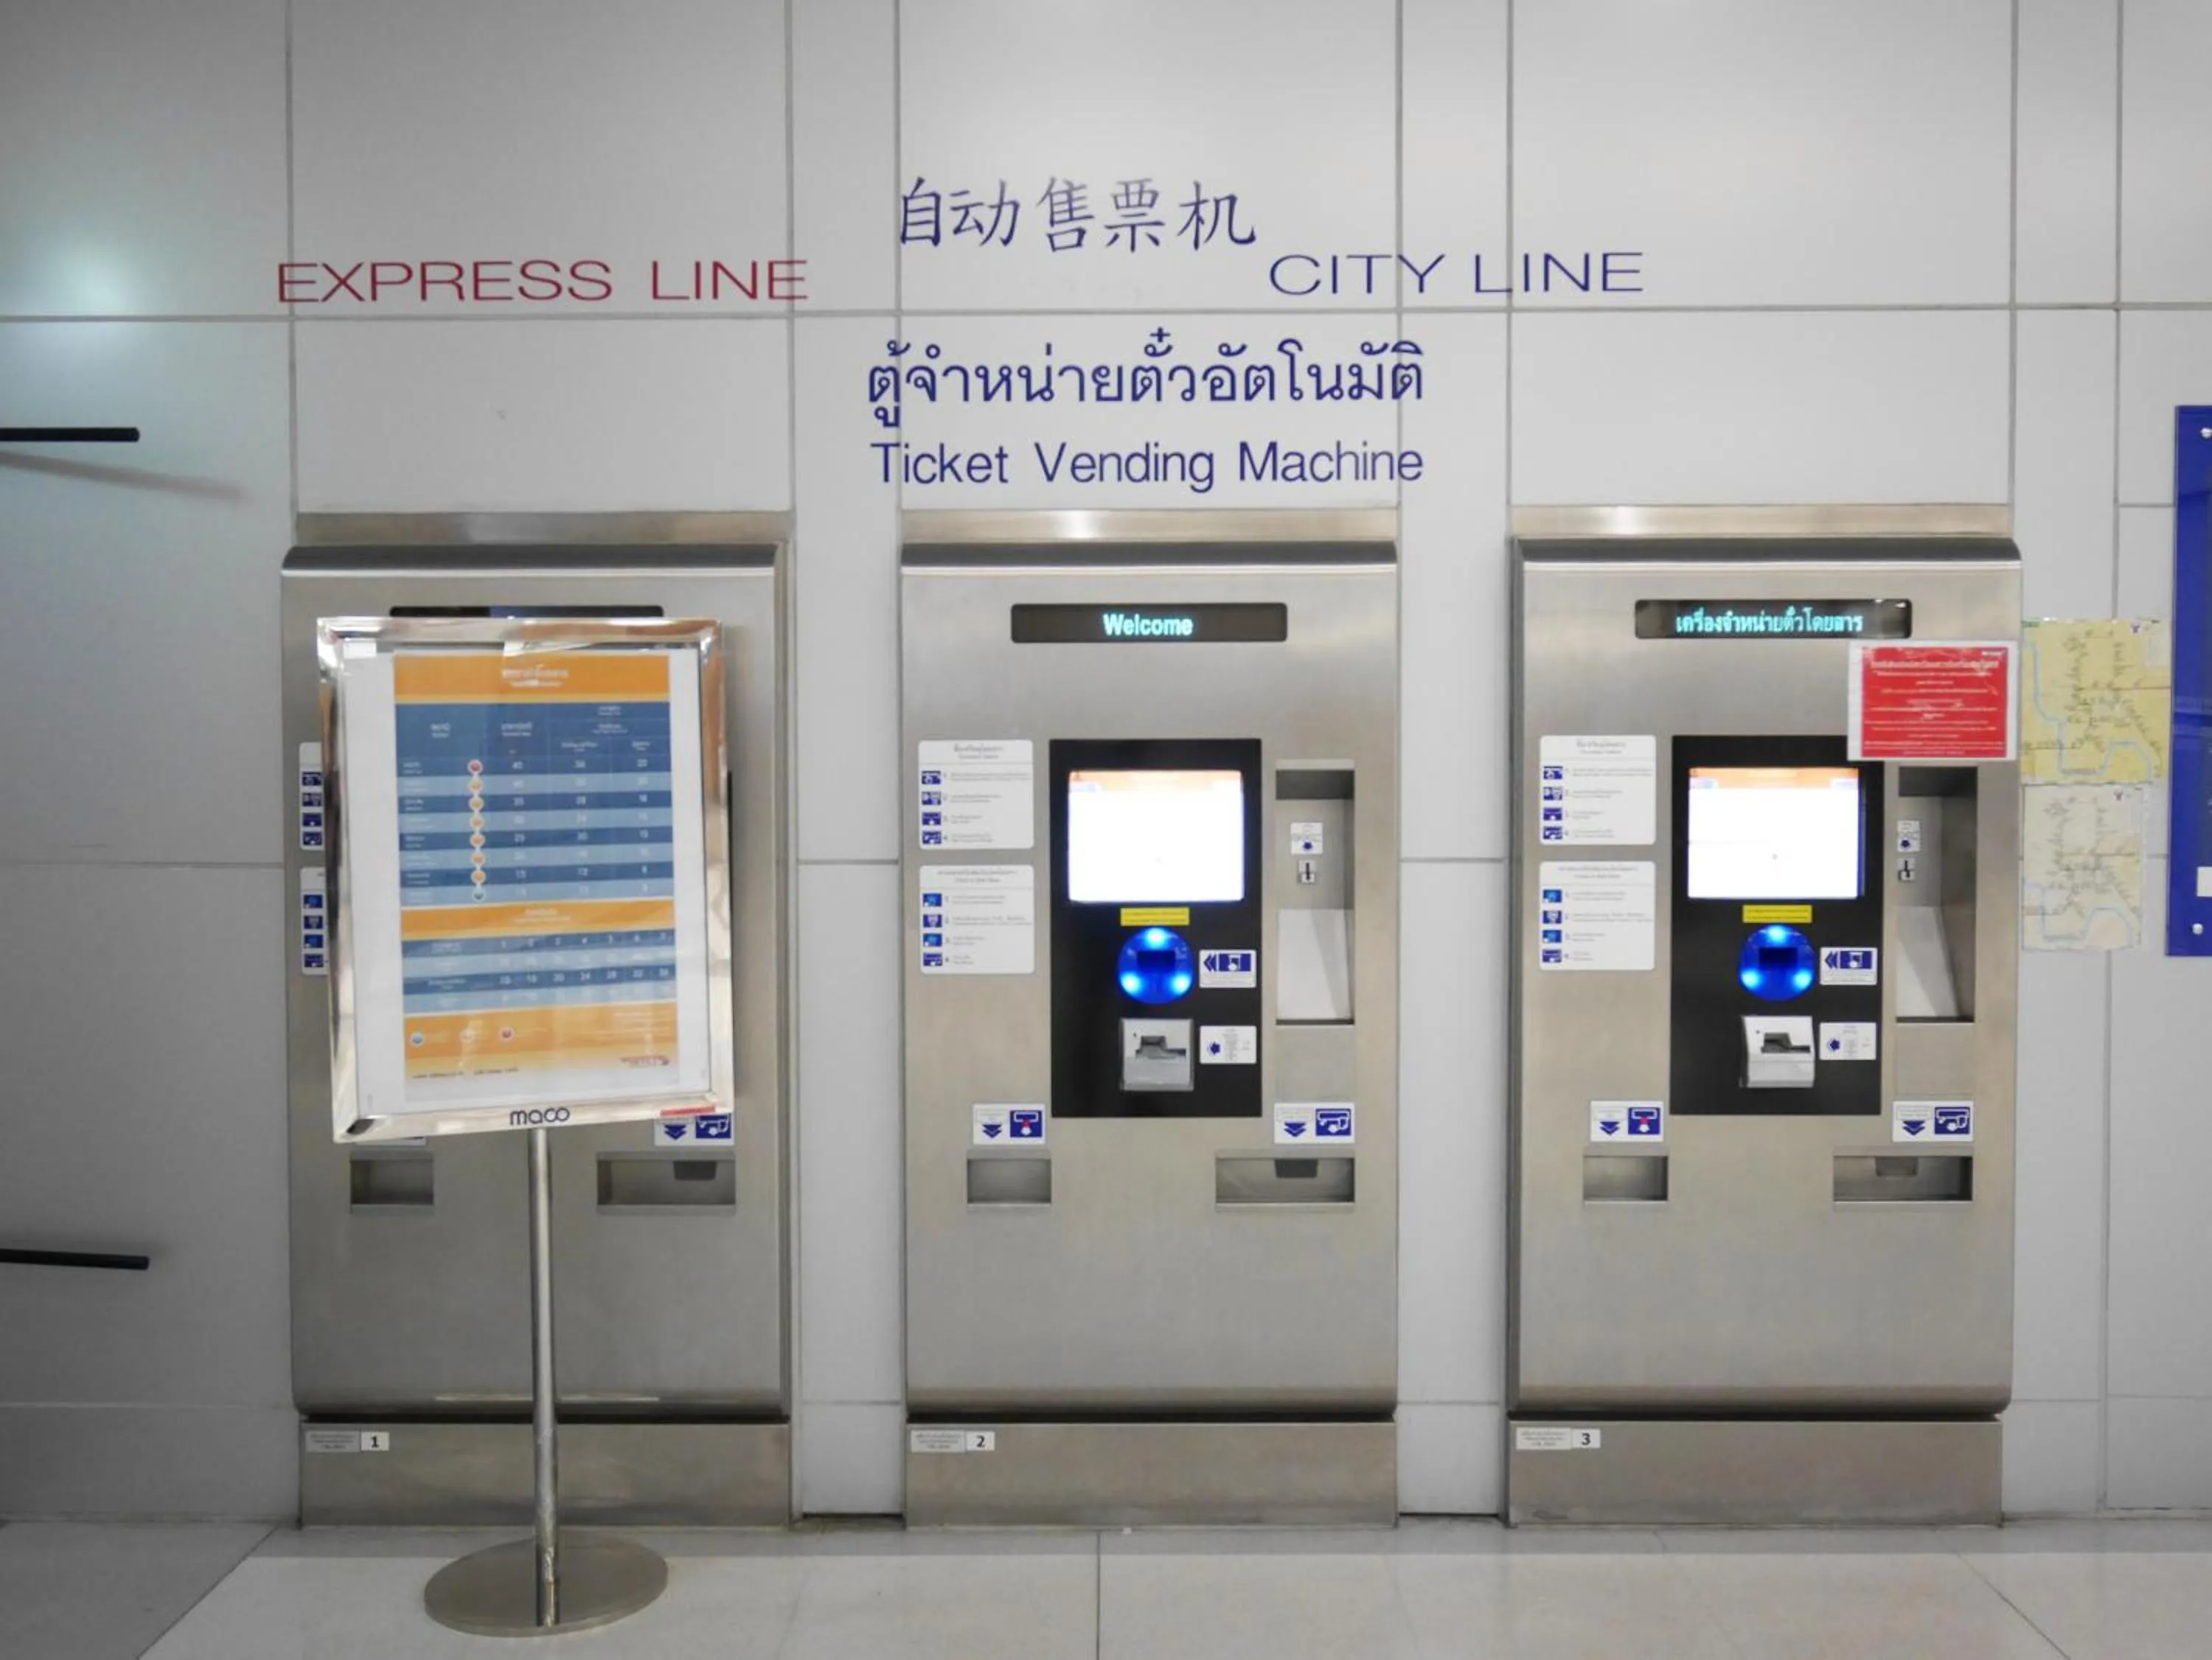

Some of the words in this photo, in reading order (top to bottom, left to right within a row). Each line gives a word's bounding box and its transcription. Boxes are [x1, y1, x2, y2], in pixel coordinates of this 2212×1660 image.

[899, 175, 1256, 253] 自动售票机
[277, 260, 613, 302] EXPRESS
[651, 259, 809, 301] LINE
[1269, 254, 1446, 296] CITY
[1475, 252, 1644, 293] LINE
[868, 327, 1424, 429] ตู้จำหน่ายตั๋วอัตโนมัติ
[871, 442, 1009, 485] Ticket
[1035, 442, 1216, 494] Vending
[1238, 440, 1425, 484] Machine
[1103, 613, 1194, 636] Welcome
[509, 1106, 571, 1126] maco
[371, 1436, 379, 1448] 1
[976, 1435, 986, 1448] 2
[1581, 1432, 1591, 1445] 3
